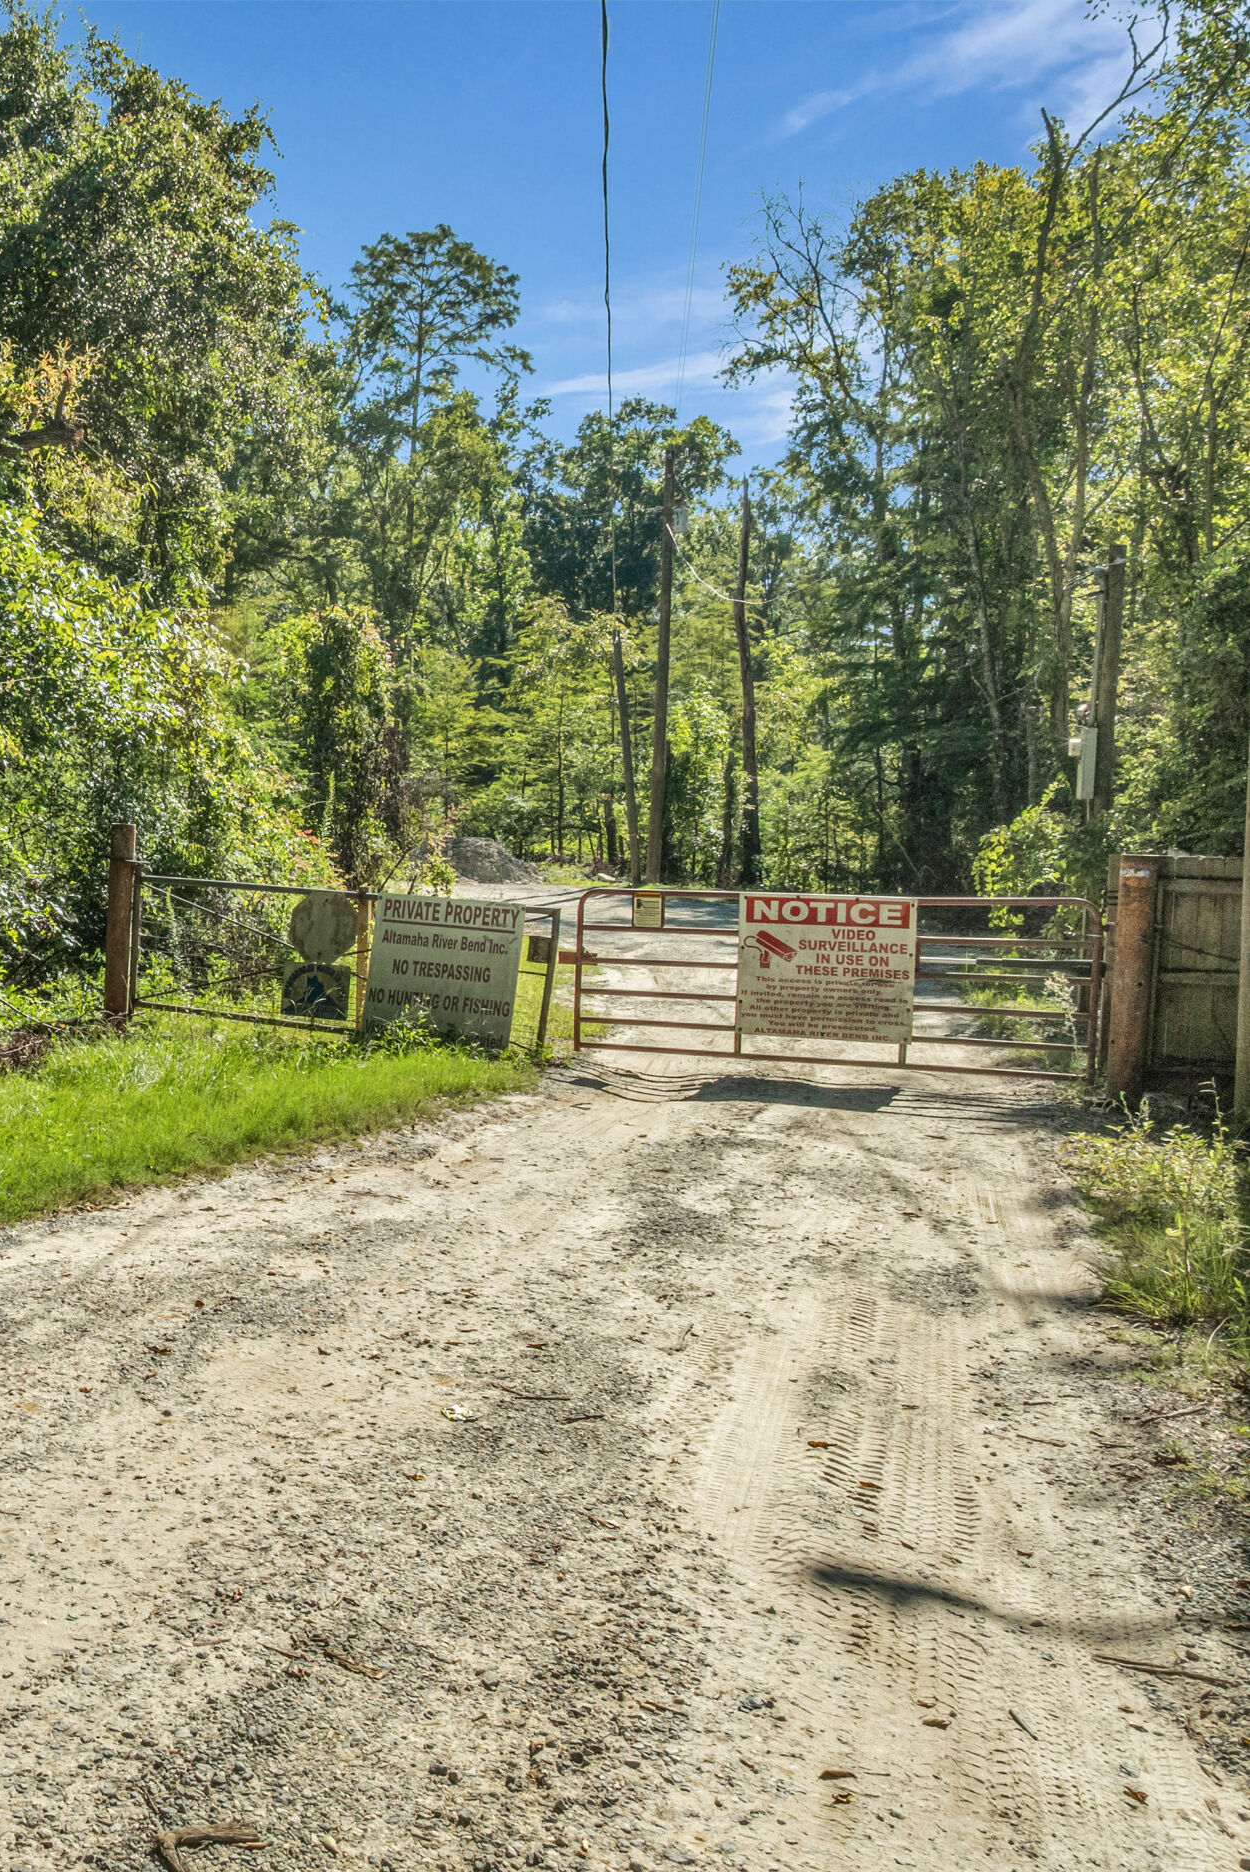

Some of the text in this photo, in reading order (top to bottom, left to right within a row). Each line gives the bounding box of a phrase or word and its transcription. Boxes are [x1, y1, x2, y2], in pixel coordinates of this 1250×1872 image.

[383, 898, 521, 929] PRIVATE PROPERTY
[753, 899, 903, 926] NOTICE
[831, 928, 876, 941] VIDEO
[382, 929, 508, 955] Altamaha River Bend Inc.
[798, 939, 908, 955] SURVEILLANCE
[816, 953, 890, 967] IN USE ON
[392, 958, 491, 983] NO TRESPASSING
[795, 965, 910, 980] THESE PREMISES
[779, 985, 820, 993] property
[368, 987, 385, 1004] NO
[442, 995, 459, 1013] OR
[461, 997, 511, 1017] FISHING
[773, 998, 814, 1007] property
[791, 1007, 832, 1015] property
[845, 1010, 879, 1018] private
[810, 1015, 863, 1024] permission
[754, 1027, 807, 1036] ALTAMAHA
[809, 1029, 839, 1038] RIVER
